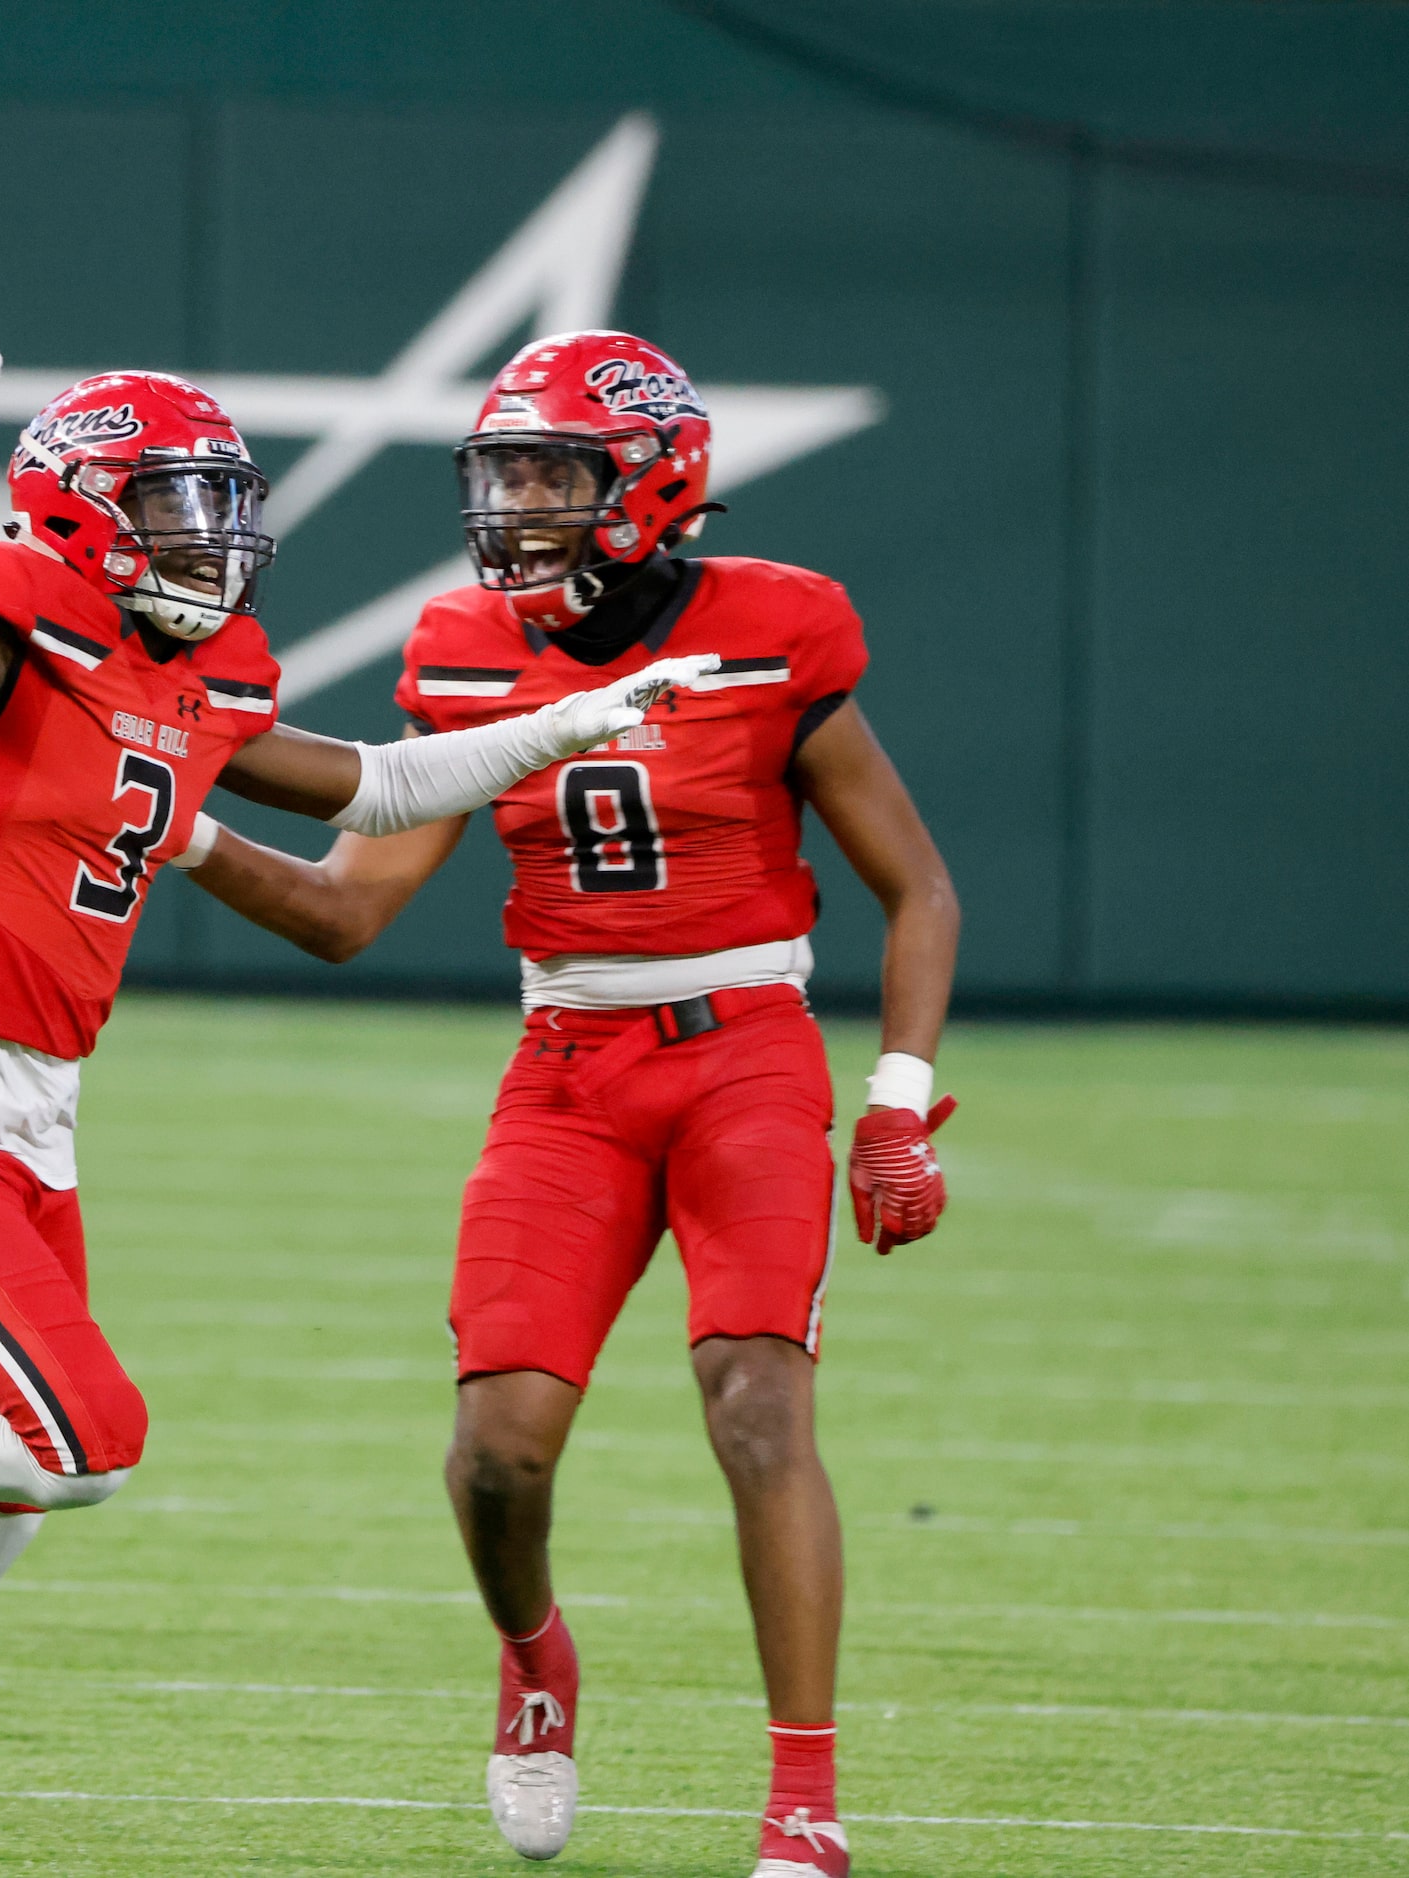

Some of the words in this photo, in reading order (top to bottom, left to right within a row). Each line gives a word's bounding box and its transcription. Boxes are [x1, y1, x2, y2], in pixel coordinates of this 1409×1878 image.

[24, 403, 143, 450] orns
[112, 710, 155, 748] CEDAR
[157, 724, 190, 759] HILL
[69, 748, 176, 924] 3
[555, 760, 669, 893] 8
